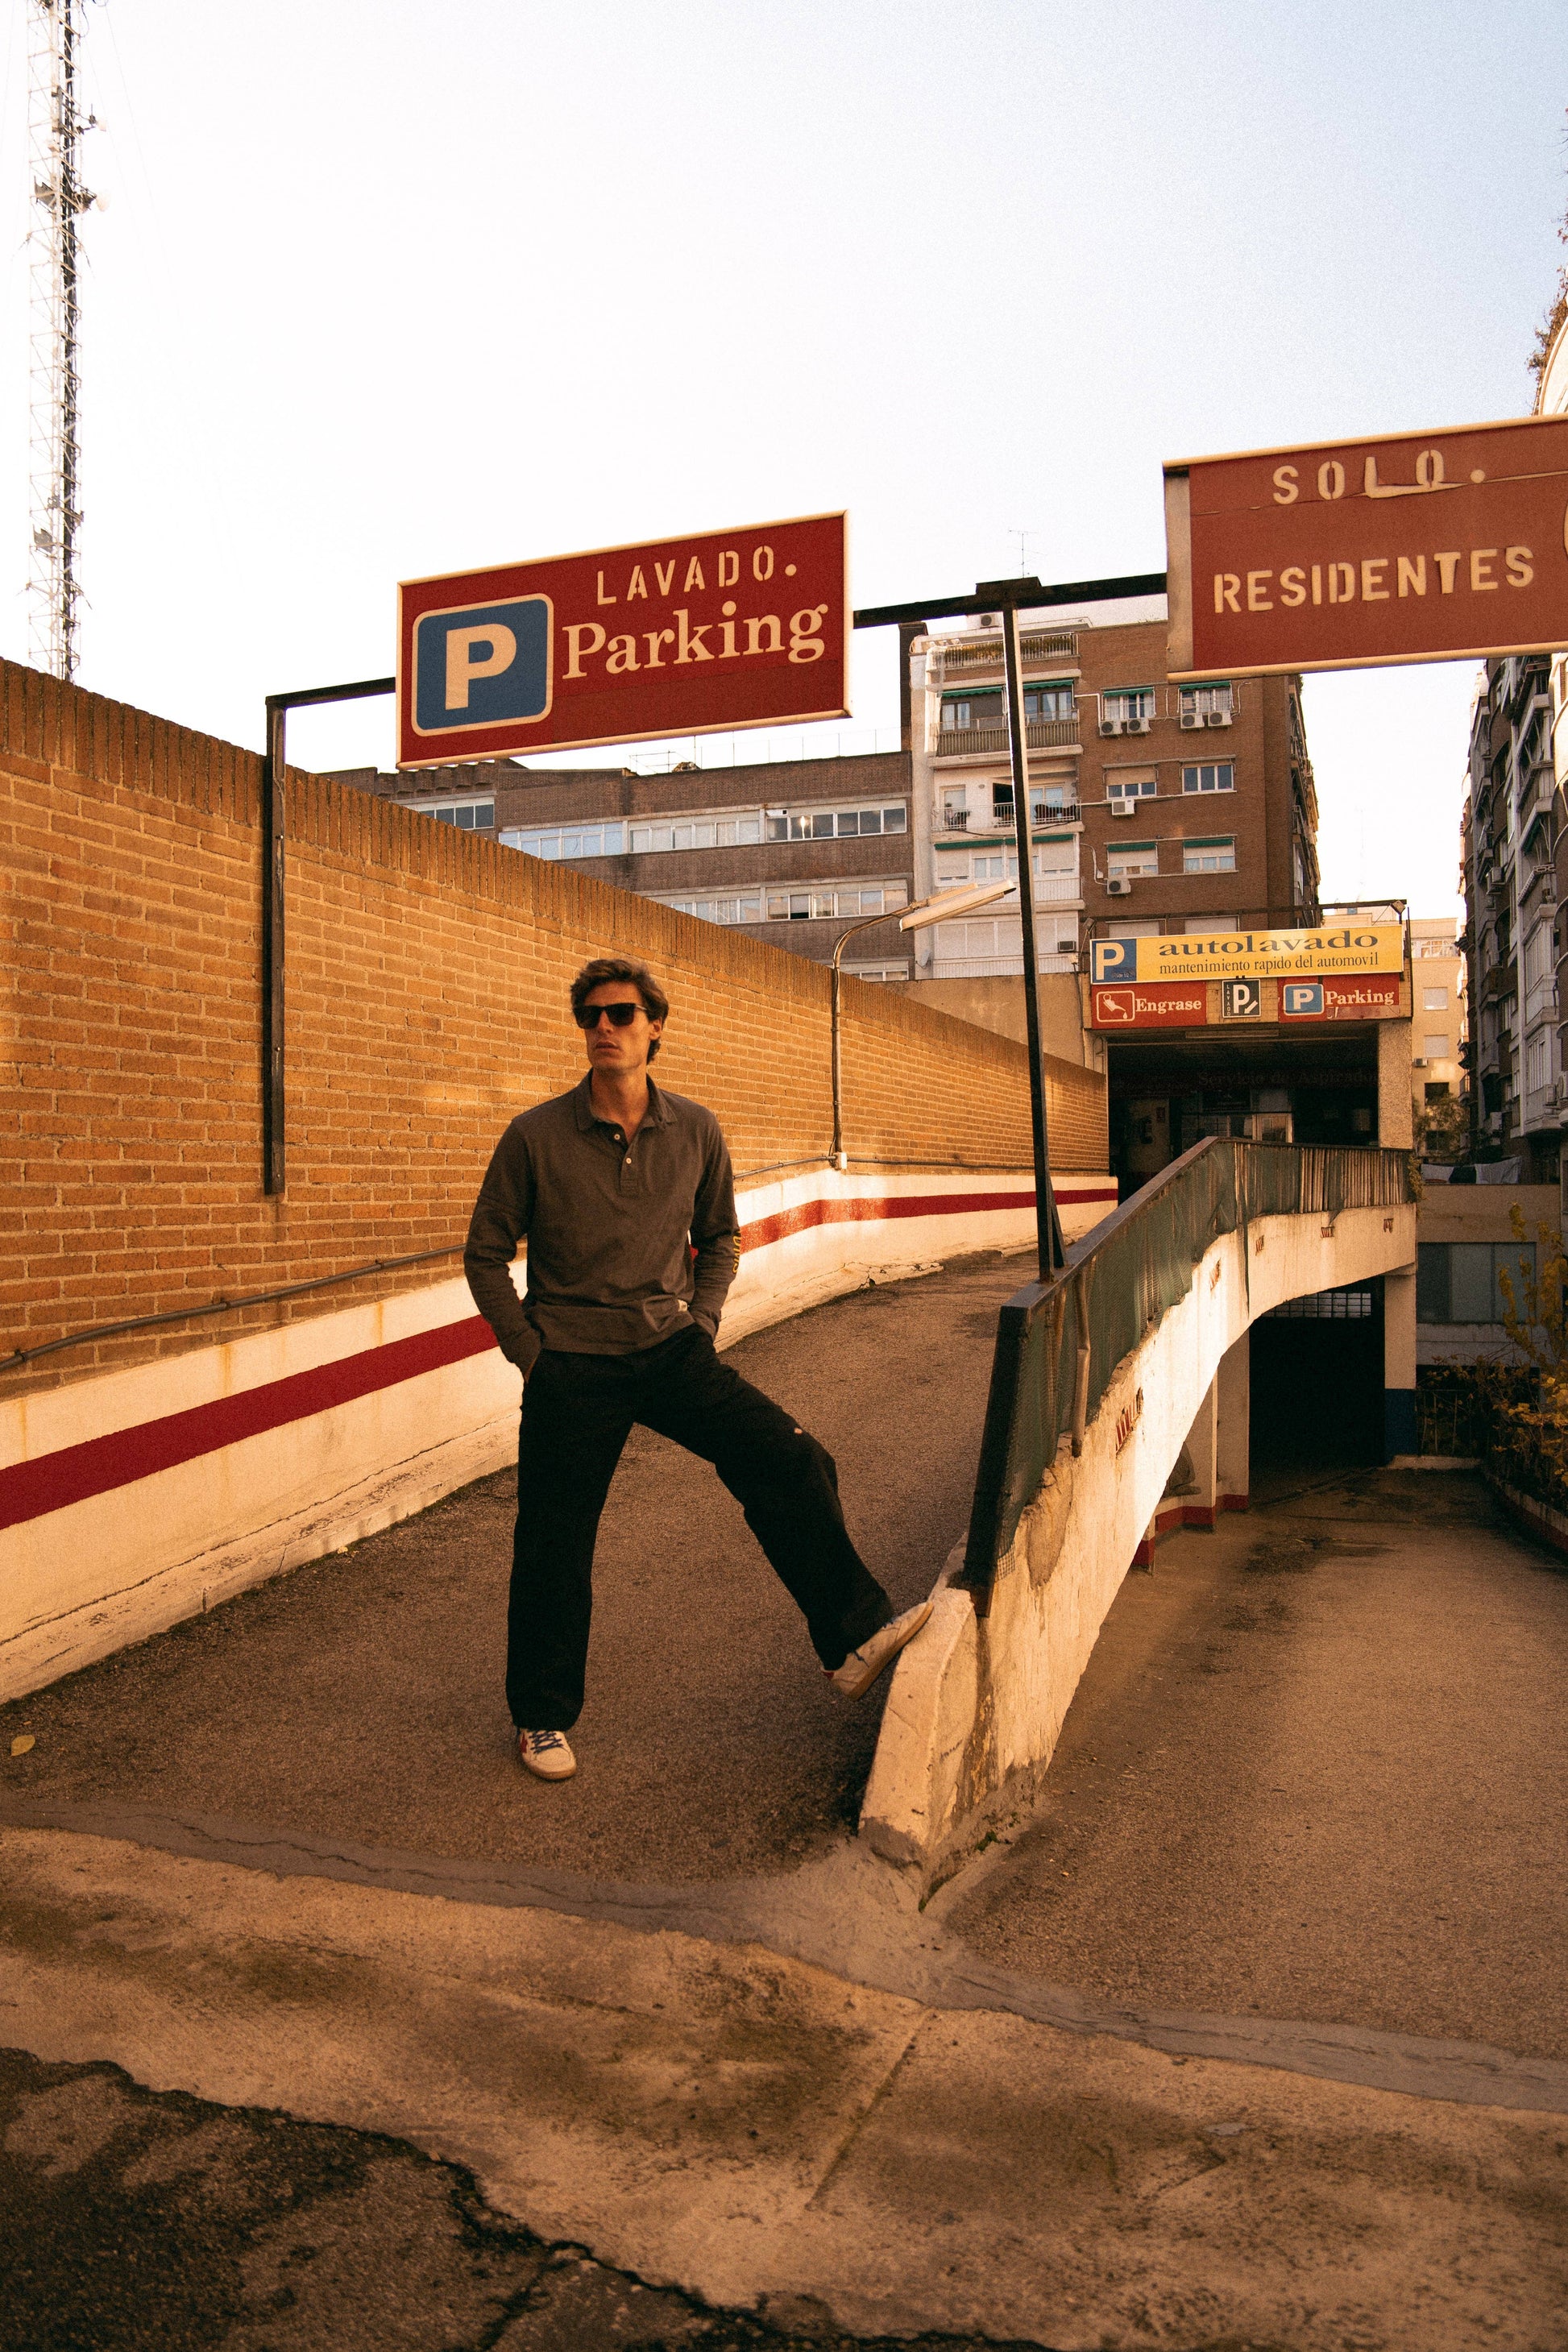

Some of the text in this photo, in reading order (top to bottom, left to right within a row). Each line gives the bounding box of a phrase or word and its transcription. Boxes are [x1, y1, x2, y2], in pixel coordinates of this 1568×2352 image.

[1214, 545, 1534, 613] RESIDENTES
[562, 600, 828, 679] Parking
[444, 623, 517, 711] P
[1159, 930, 1378, 956] autolavado
[1096, 942, 1125, 980] P
[1159, 952, 1379, 974] mantenimiento rapido del automovil
[1135, 998, 1201, 1014] Engrase
[1233, 984, 1250, 1014] P
[1293, 989, 1313, 1010] P
[1325, 989, 1394, 1006] Parking
